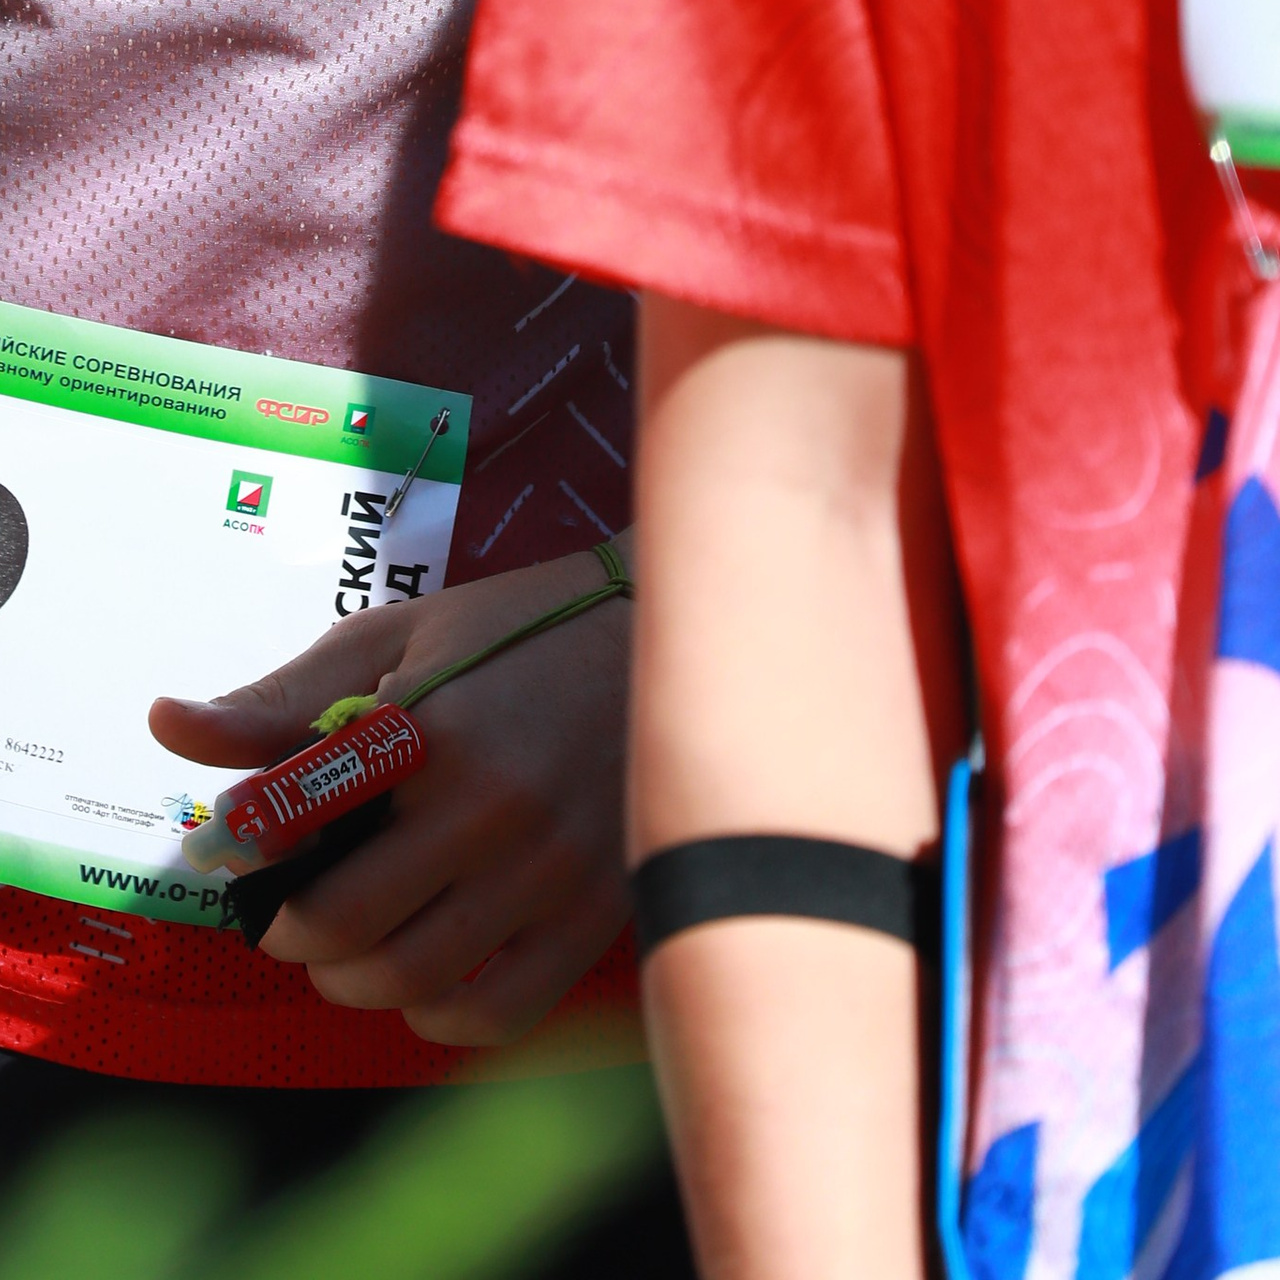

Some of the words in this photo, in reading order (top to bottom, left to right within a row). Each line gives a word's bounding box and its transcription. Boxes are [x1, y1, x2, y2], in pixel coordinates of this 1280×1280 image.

[59, 374, 227, 420] ориентированию
[72, 354, 242, 402] СОРЕВНОВАНИЯ
[223, 518, 265, 536] АСОПК
[332, 491, 387, 625] СКИЙ
[4, 737, 64, 764] 8642222
[303, 755, 357, 793] 53947
[71, 803, 91, 814] ООО
